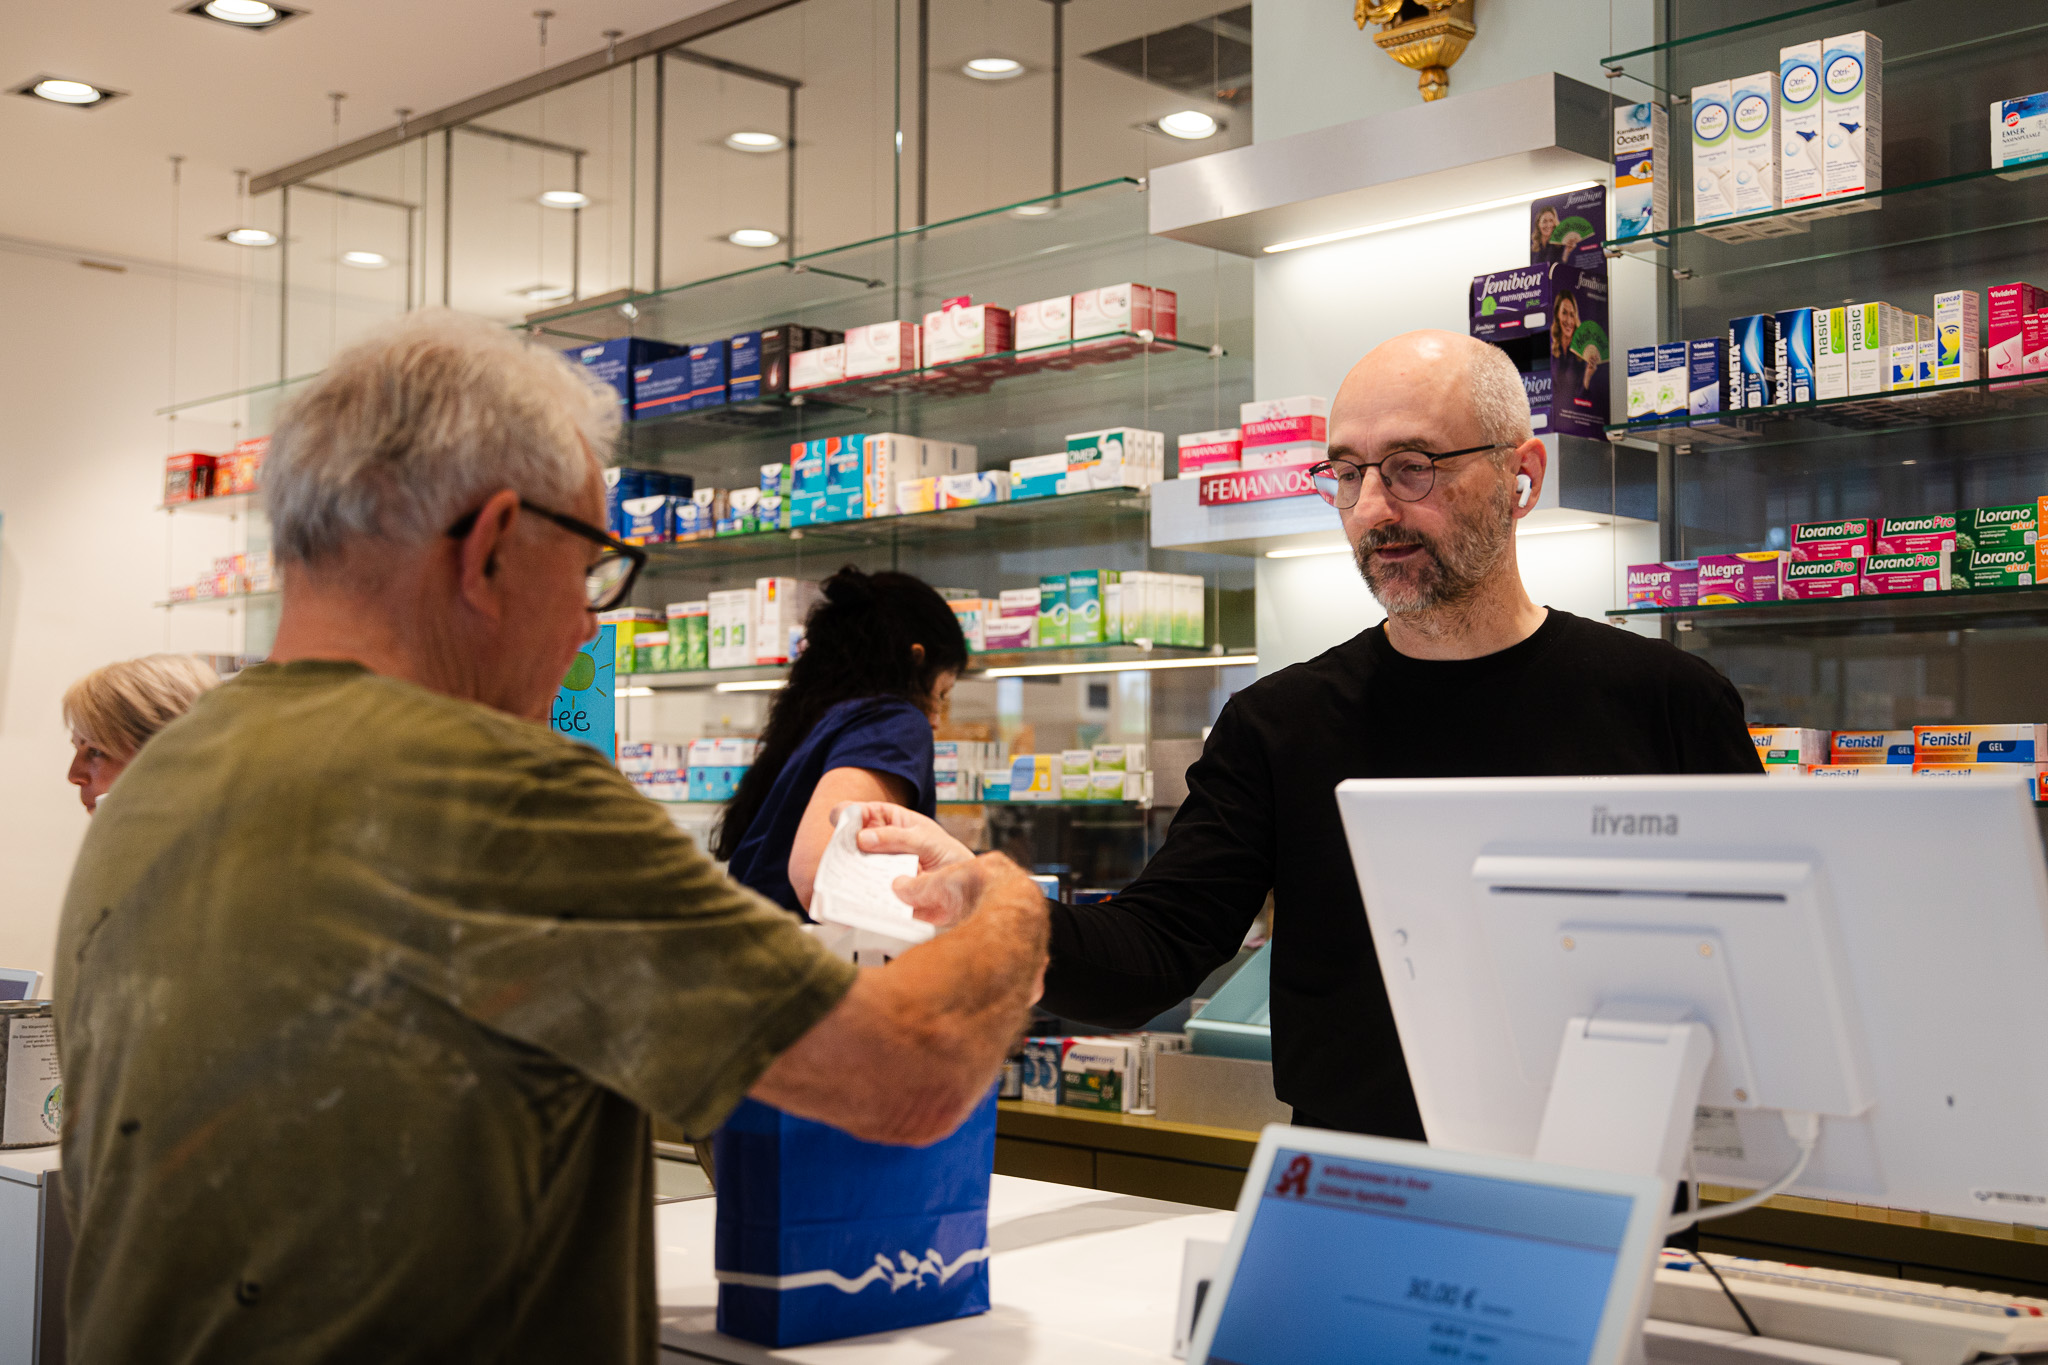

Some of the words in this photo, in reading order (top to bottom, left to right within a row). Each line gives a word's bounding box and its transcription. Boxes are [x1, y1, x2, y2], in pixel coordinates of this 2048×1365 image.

[1831, 75, 1856, 85] Natural
[1788, 84, 1812, 94] Natural
[1739, 114, 1763, 123] Natural
[1699, 122, 1723, 131] Natural
[1616, 133, 1650, 145] Ocean
[1477, 271, 1542, 301] femibion
[1990, 289, 2018, 298] Vividrin
[1525, 298, 1541, 309] plus
[1814, 315, 1828, 355] nasic
[1848, 309, 1861, 351] nasic
[1729, 343, 1741, 410] MOMETA
[1775, 337, 1788, 404] MOMETA
[1524, 376, 1551, 395] bion
[1979, 508, 2031, 523] Lorano
[2010, 519, 2036, 531] akut
[1974, 550, 2026, 565] Lorano
[1699, 564, 1744, 578] Allegra
[2005, 561, 2030, 573] akut
[1628, 571, 1671, 586] Allegra
[549, 695, 591, 732] fee
[1753, 735, 1772, 746] istil
[1837, 734, 1884, 748] Fenistil
[1897, 746, 1911, 755] GEL
[1921, 731, 1972, 747] Fenistil
[1988, 742, 2004, 752] GEL
[1591, 805, 1679, 835] iiyama
